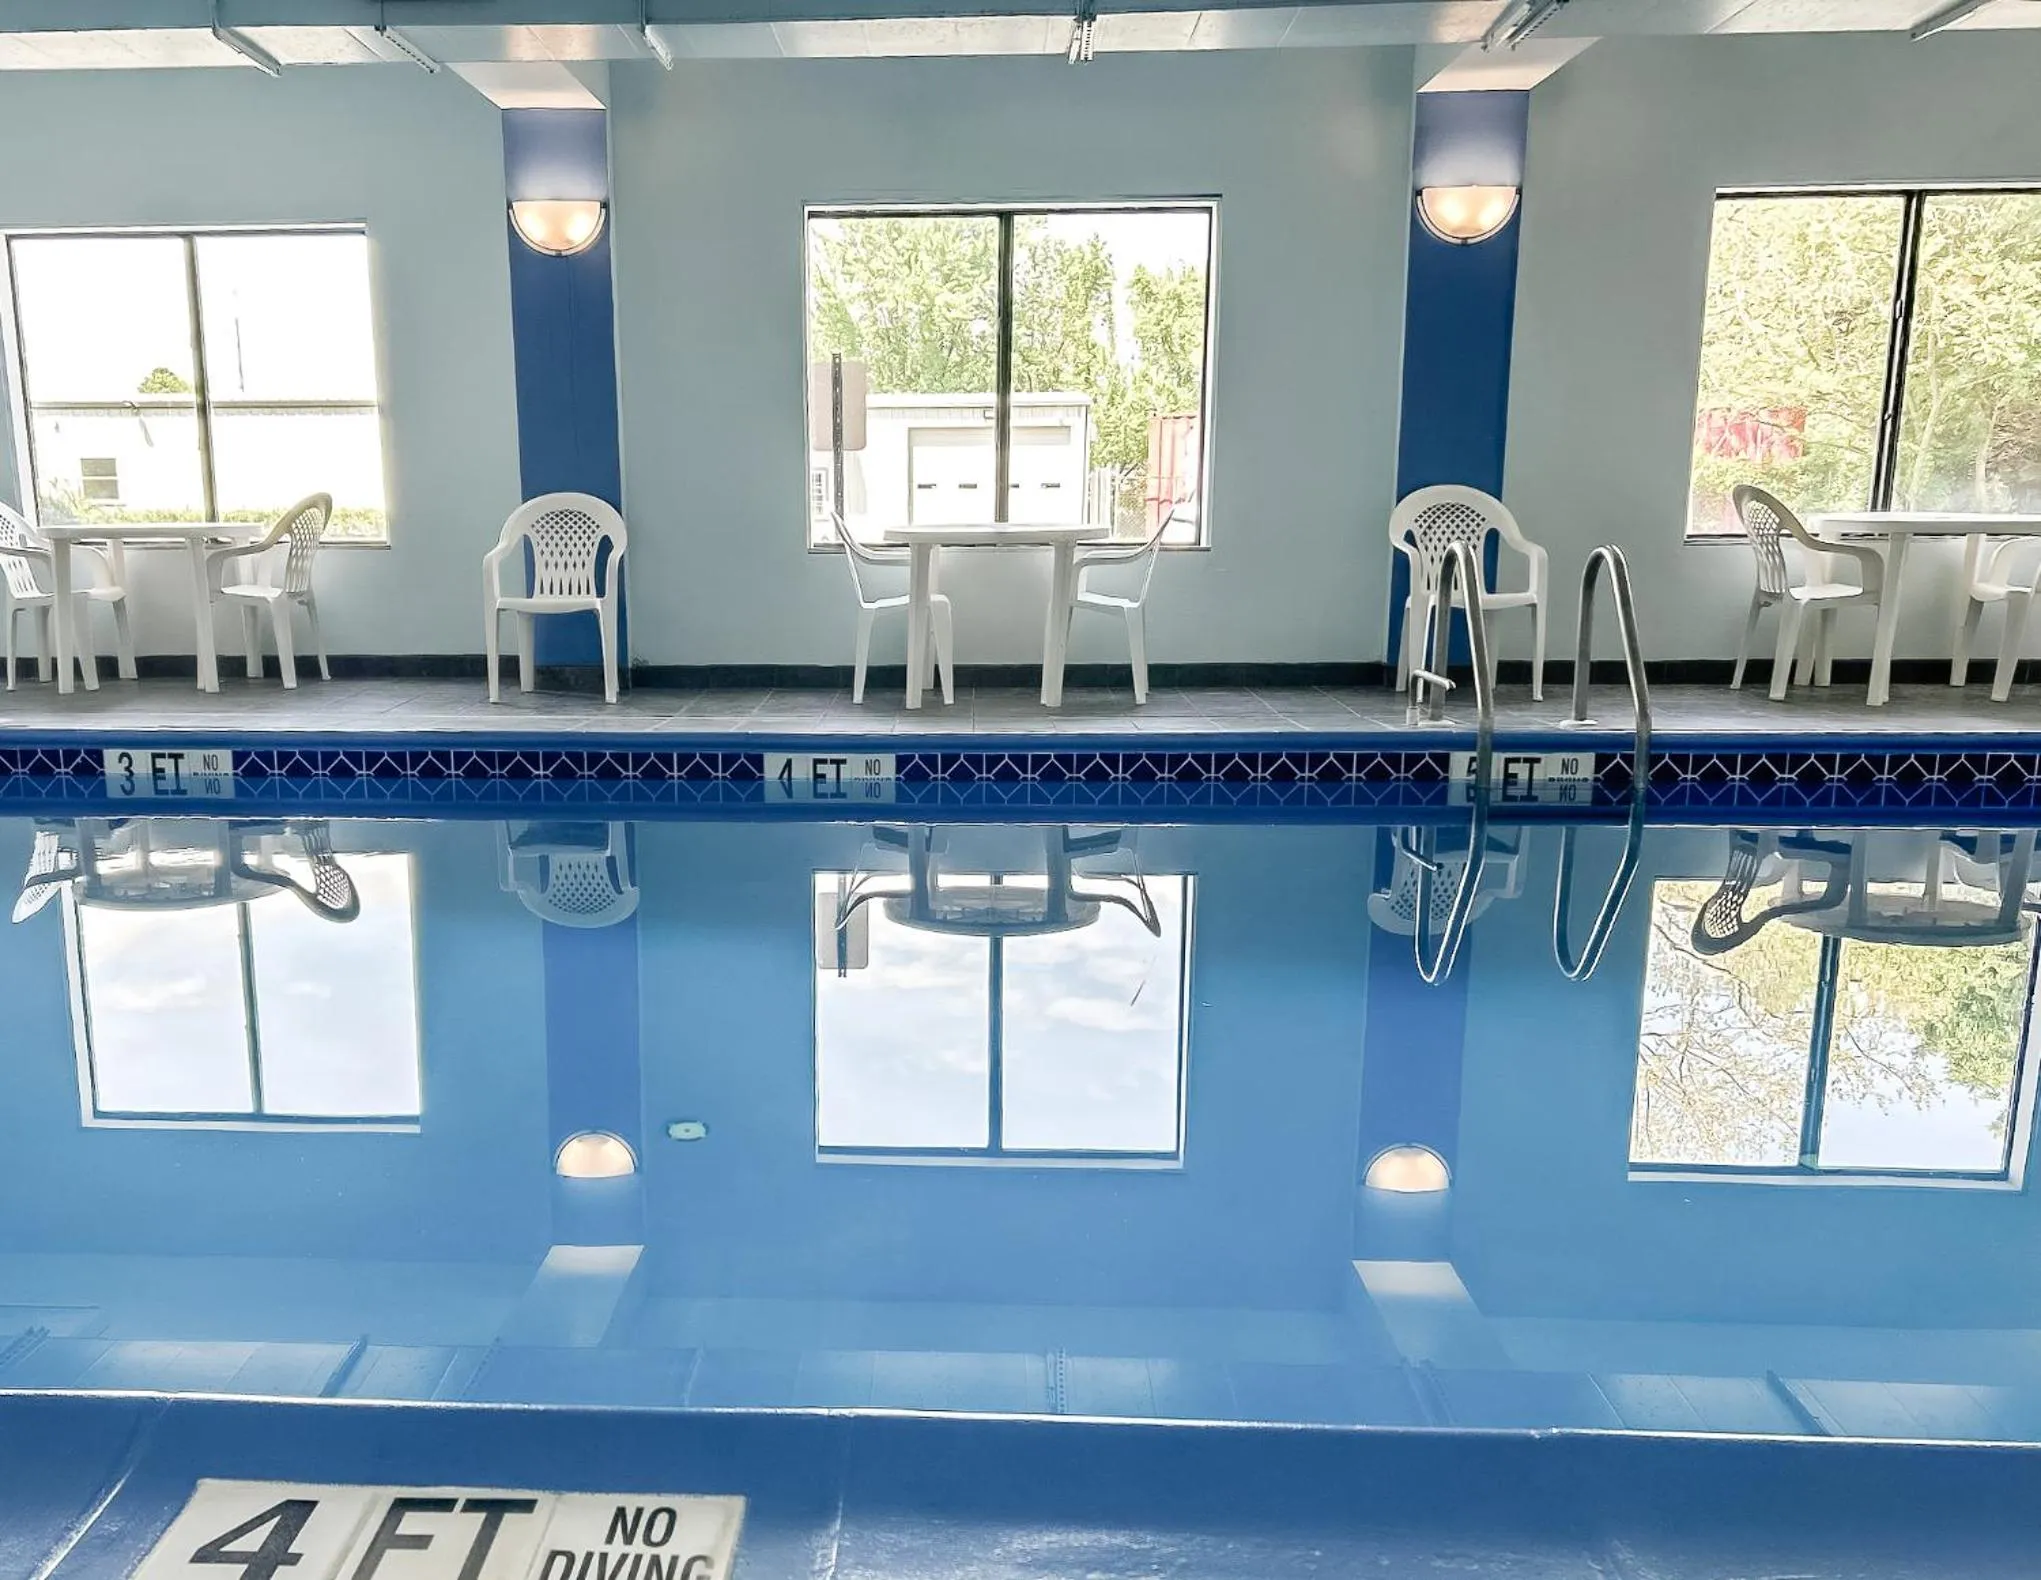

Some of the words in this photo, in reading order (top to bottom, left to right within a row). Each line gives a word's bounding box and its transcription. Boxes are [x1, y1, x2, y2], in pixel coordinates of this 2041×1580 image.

[203, 754, 219, 771] NO
[865, 759, 881, 776] NO
[1561, 758, 1579, 775] NO
[189, 1499, 320, 1580] 4
[351, 1497, 539, 1580] FT
[604, 1506, 677, 1547] NO
[539, 1549, 715, 1580] DIVING
